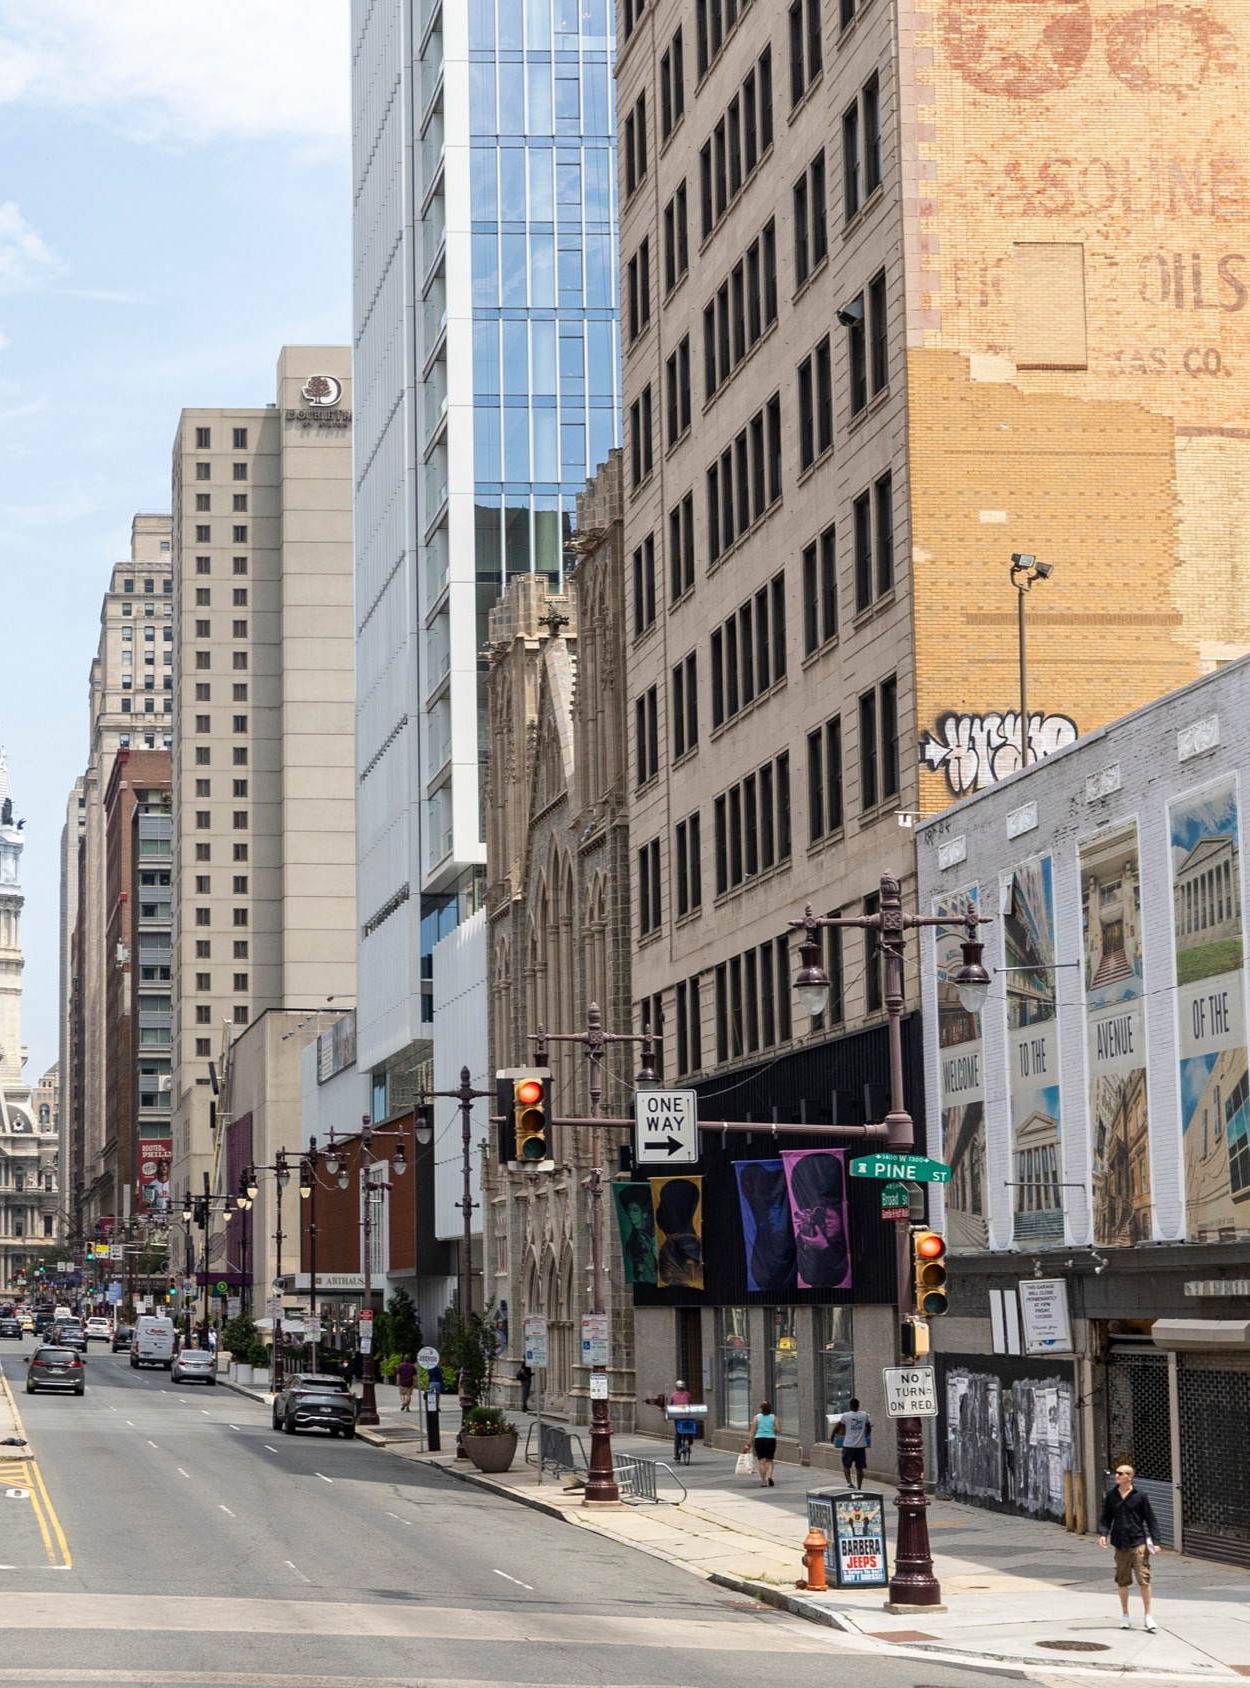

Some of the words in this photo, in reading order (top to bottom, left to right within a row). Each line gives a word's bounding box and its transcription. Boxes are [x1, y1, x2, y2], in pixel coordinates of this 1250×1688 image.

[1193, 998, 1205, 1039] OF
[1209, 992, 1229, 1035] THE
[1098, 1016, 1134, 1060] AVENUE
[1019, 1042, 1029, 1077] TO
[1031, 1038, 1046, 1075] THE
[943, 1055, 979, 1093] WELCOME
[648, 1098, 683, 1112] ONE
[646, 1116, 684, 1132] WAY
[874, 1163, 916, 1180] PINE
[932, 1172, 947, 1182] ST
[901, 1374, 919, 1383] NO
[895, 1387, 926, 1397] TURN
[890, 1401, 904, 1411] ON
[911, 1400, 932, 1410] RED
[841, 1539, 881, 1556] BARBERA
[847, 1556, 877, 1568] JEEPS
